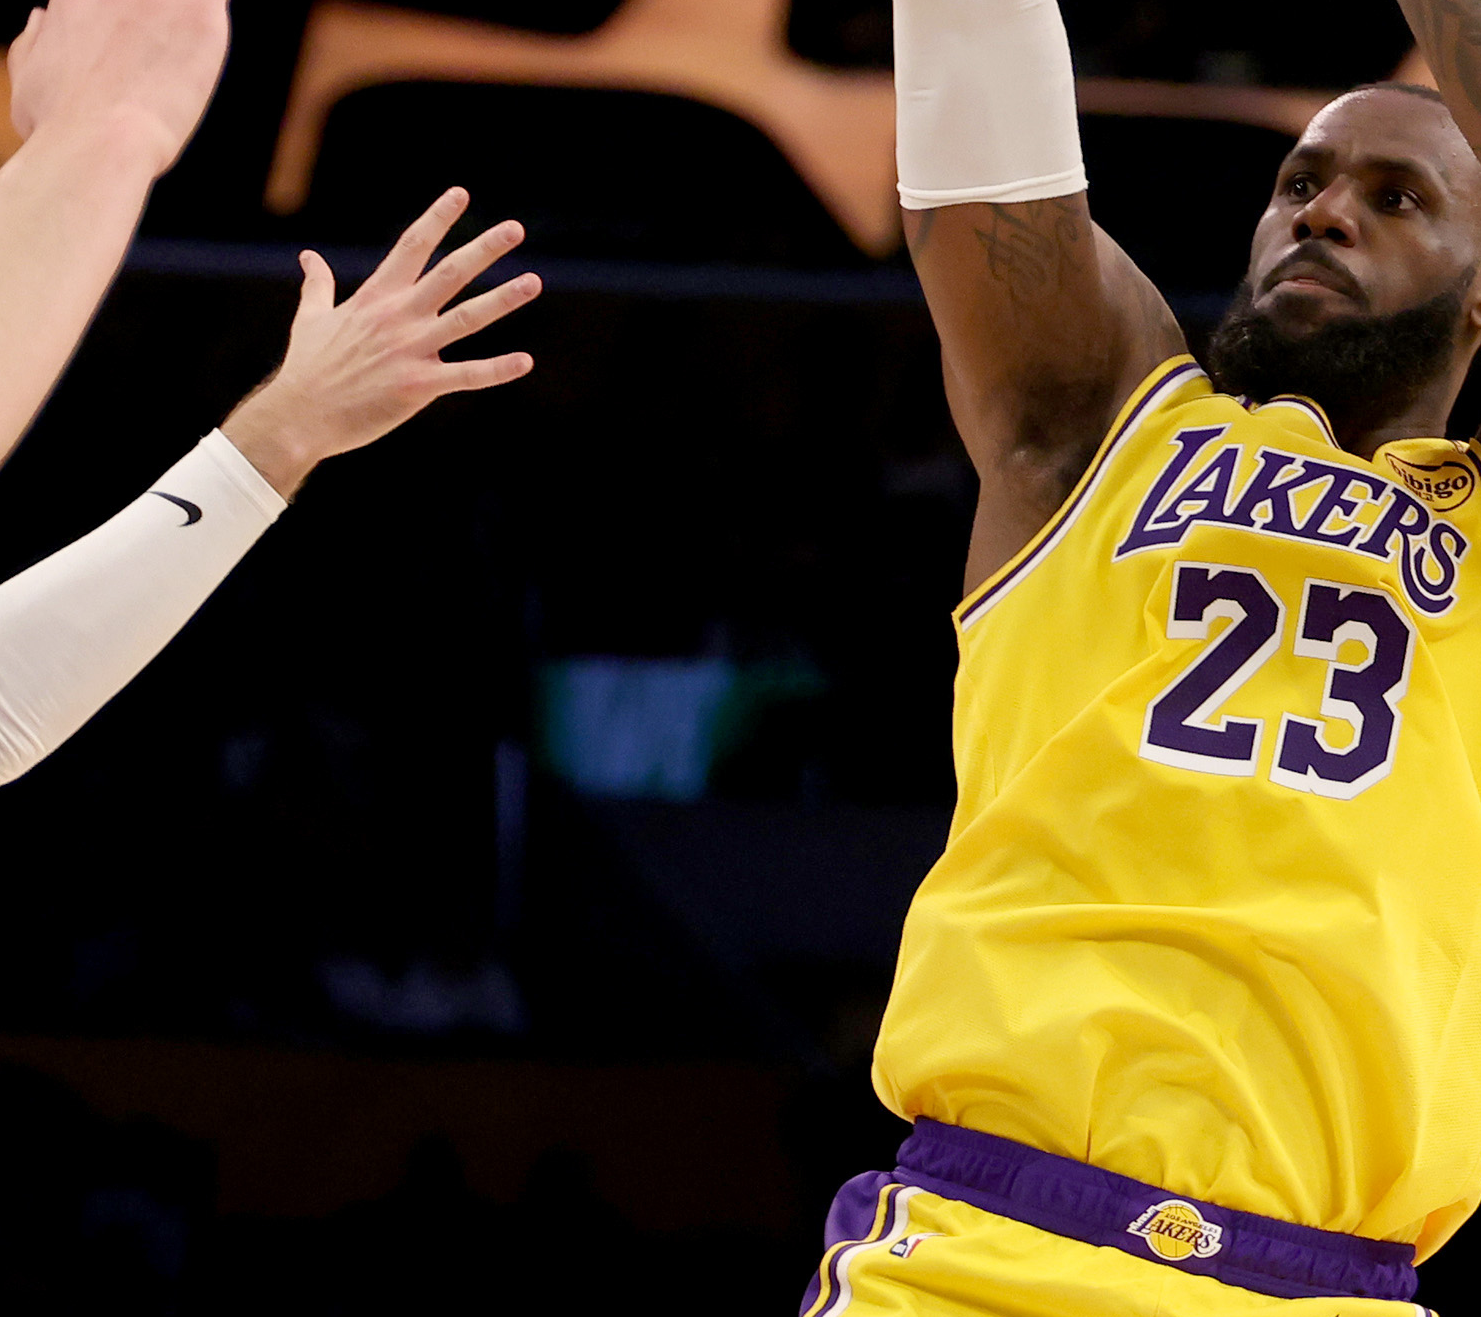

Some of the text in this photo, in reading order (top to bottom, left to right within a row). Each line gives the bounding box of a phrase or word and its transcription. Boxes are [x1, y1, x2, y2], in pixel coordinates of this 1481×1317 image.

[1112, 423, 1472, 619] LAKERS
[1138, 560, 1417, 801] 23
[1129, 1208, 1217, 1255] LAKERS
